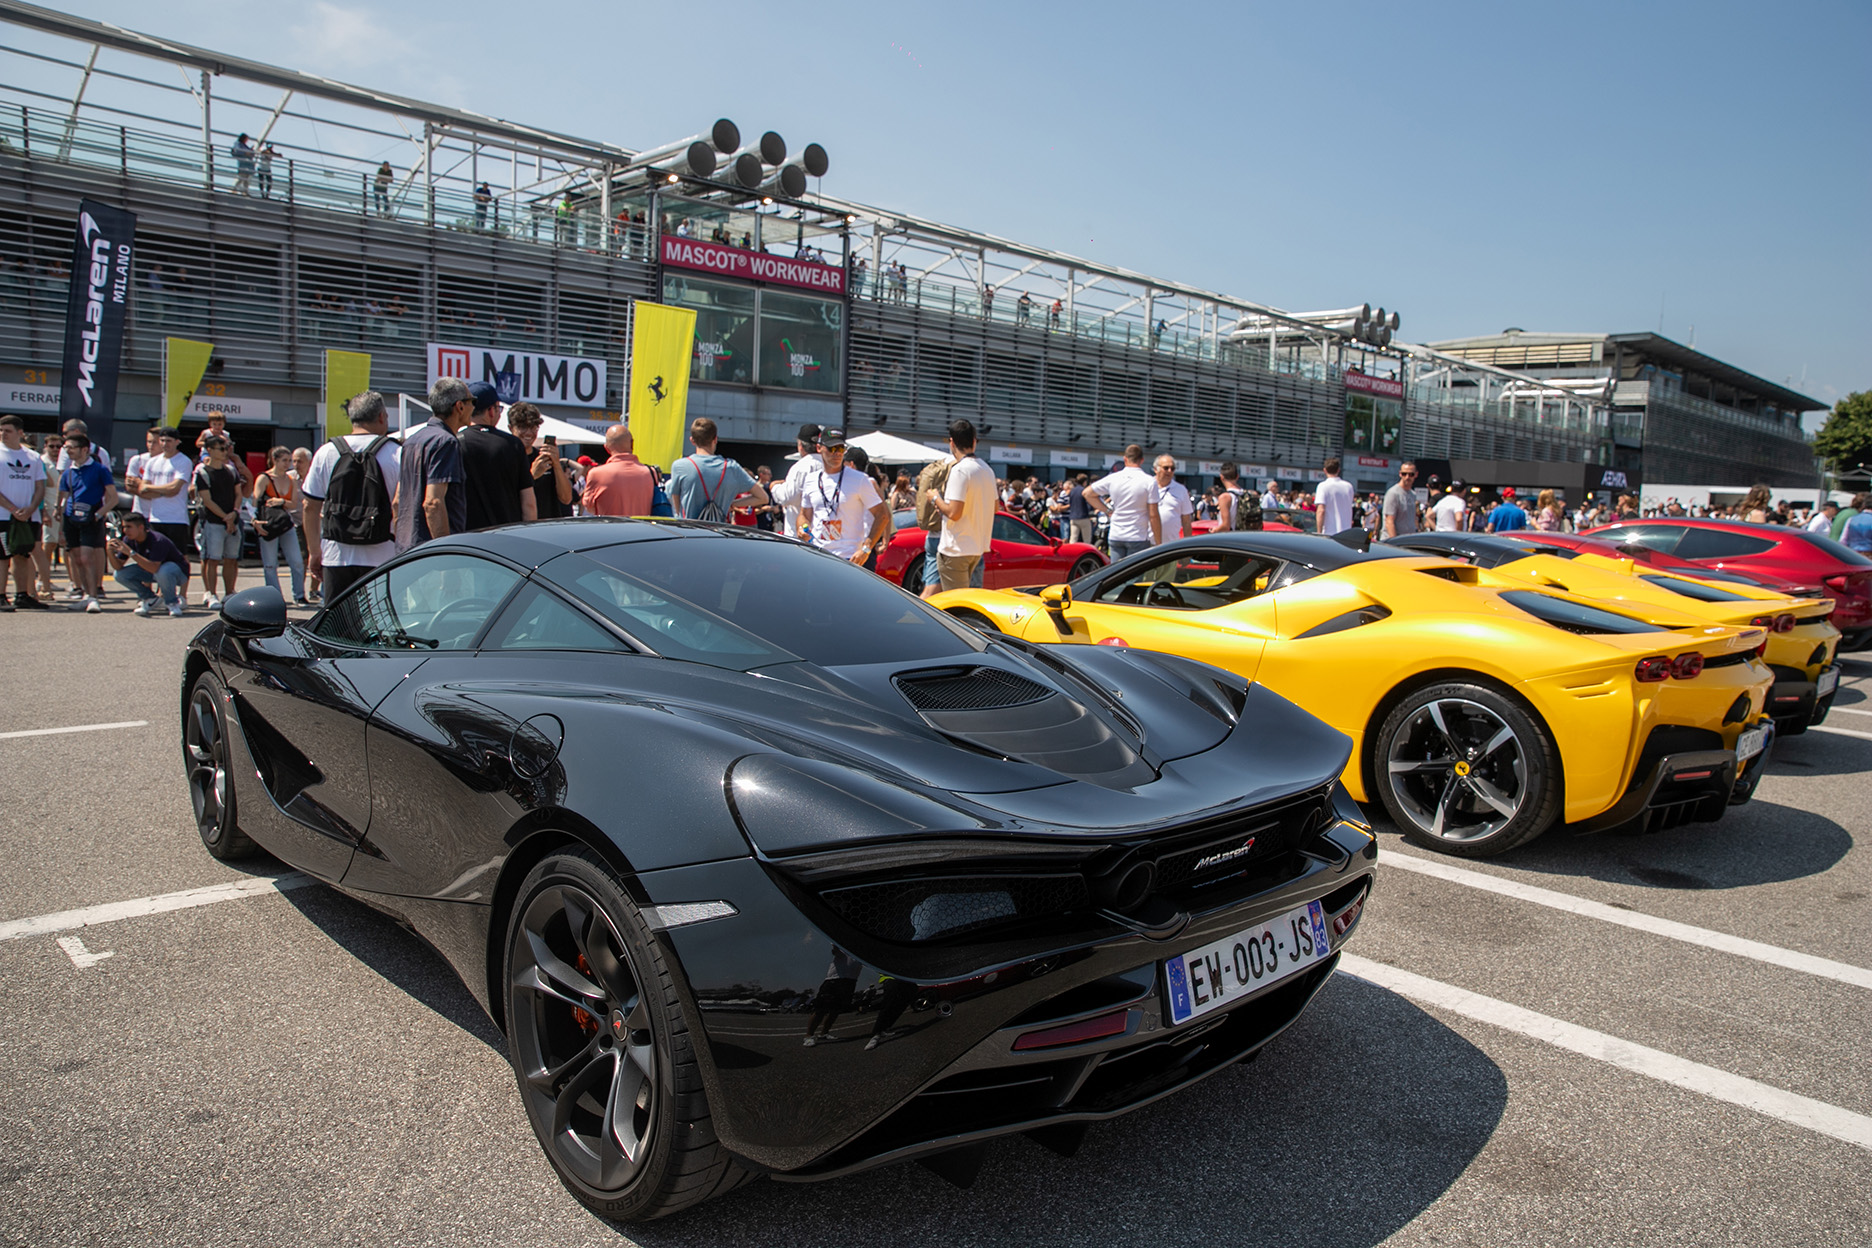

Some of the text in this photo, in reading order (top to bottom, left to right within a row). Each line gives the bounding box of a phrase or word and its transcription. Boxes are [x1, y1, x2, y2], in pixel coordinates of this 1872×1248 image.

[113, 245, 131, 303] MILANO
[750, 257, 841, 289] WORKWEAR
[77, 238, 111, 408] McLaren
[698, 342, 724, 354] MONZA
[699, 353, 713, 367] 100
[790, 353, 813, 365] MONZA
[24, 369, 47, 384] 31
[483, 352, 598, 403] MIMO
[791, 364, 804, 376] 100
[205, 383, 226, 397] 32
[195, 402, 241, 414] FERRARI
[1193, 845, 1250, 870] McLaren
[1178, 916, 1328, 1007] F EW-003-JS 83
